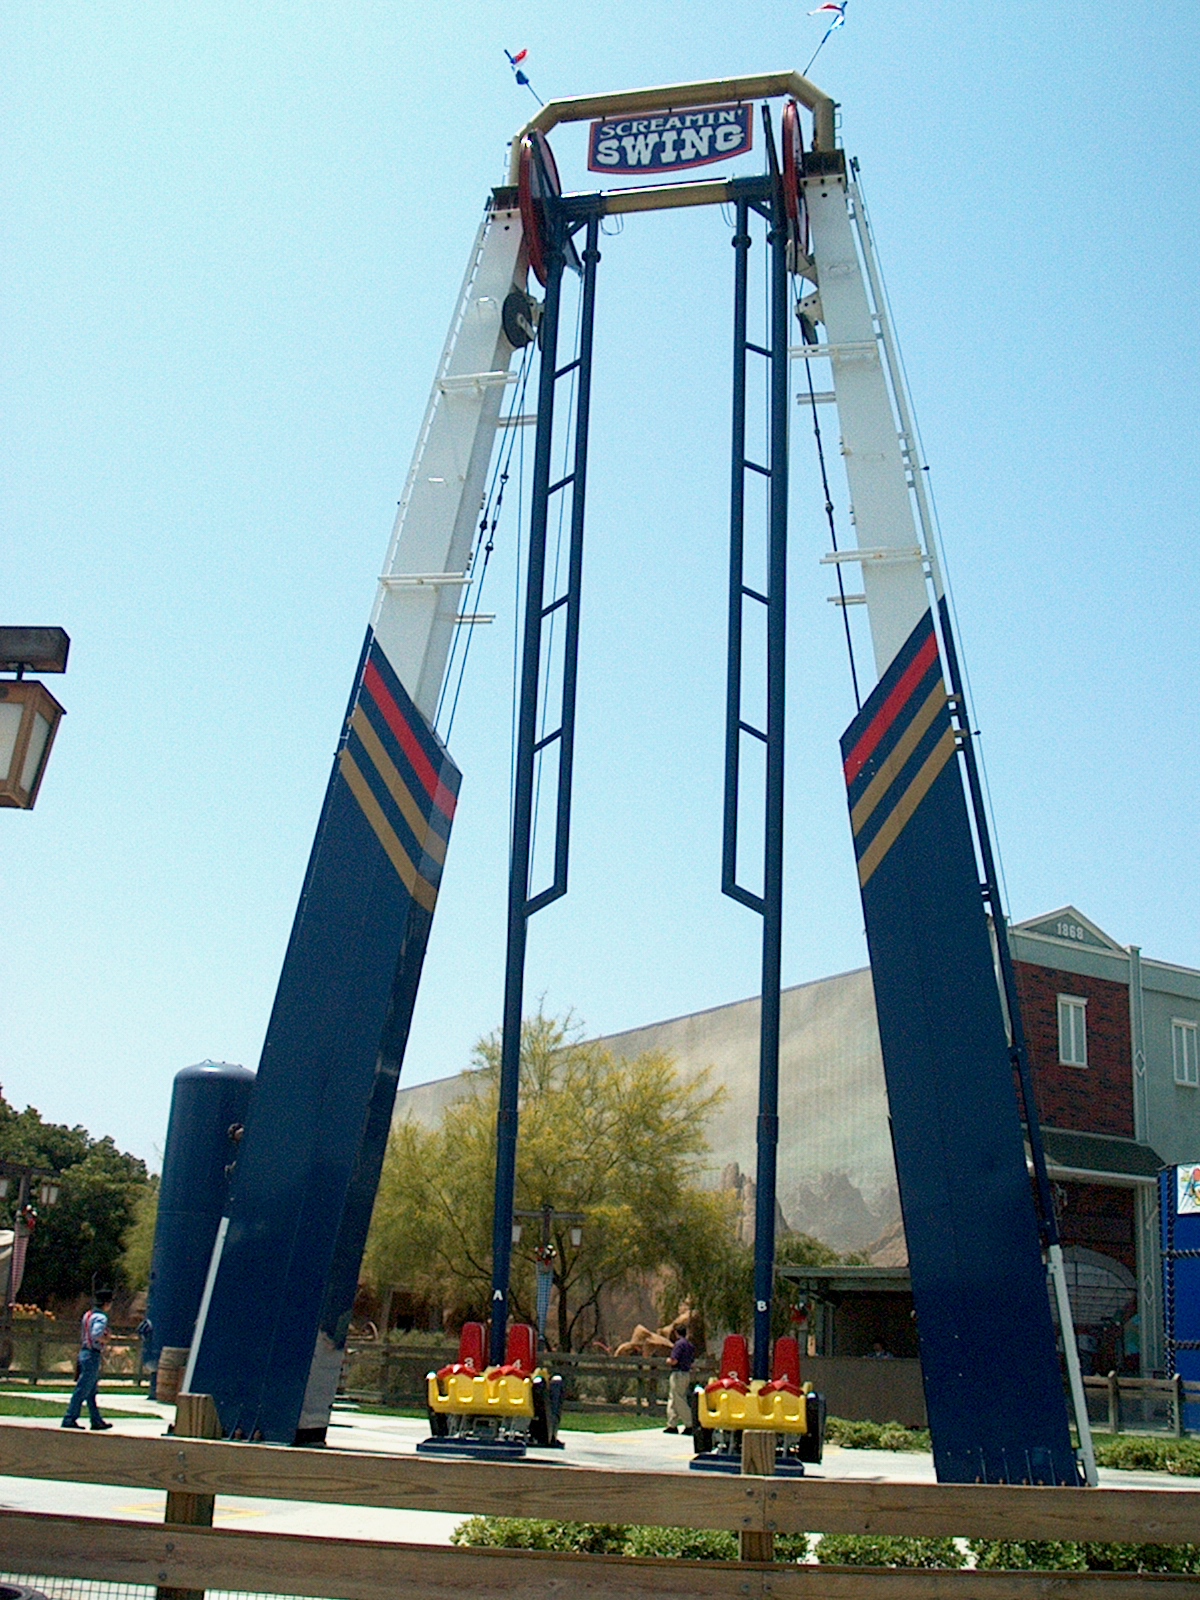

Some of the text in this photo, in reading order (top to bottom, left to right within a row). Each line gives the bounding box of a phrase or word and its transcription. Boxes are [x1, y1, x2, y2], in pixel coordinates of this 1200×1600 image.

[600, 109, 743, 139] SCREAMIN'
[596, 124, 745, 166] SWING
[1057, 922, 1084, 940] 1868
[493, 1289, 503, 1300] A
[757, 1300, 767, 1311] B
